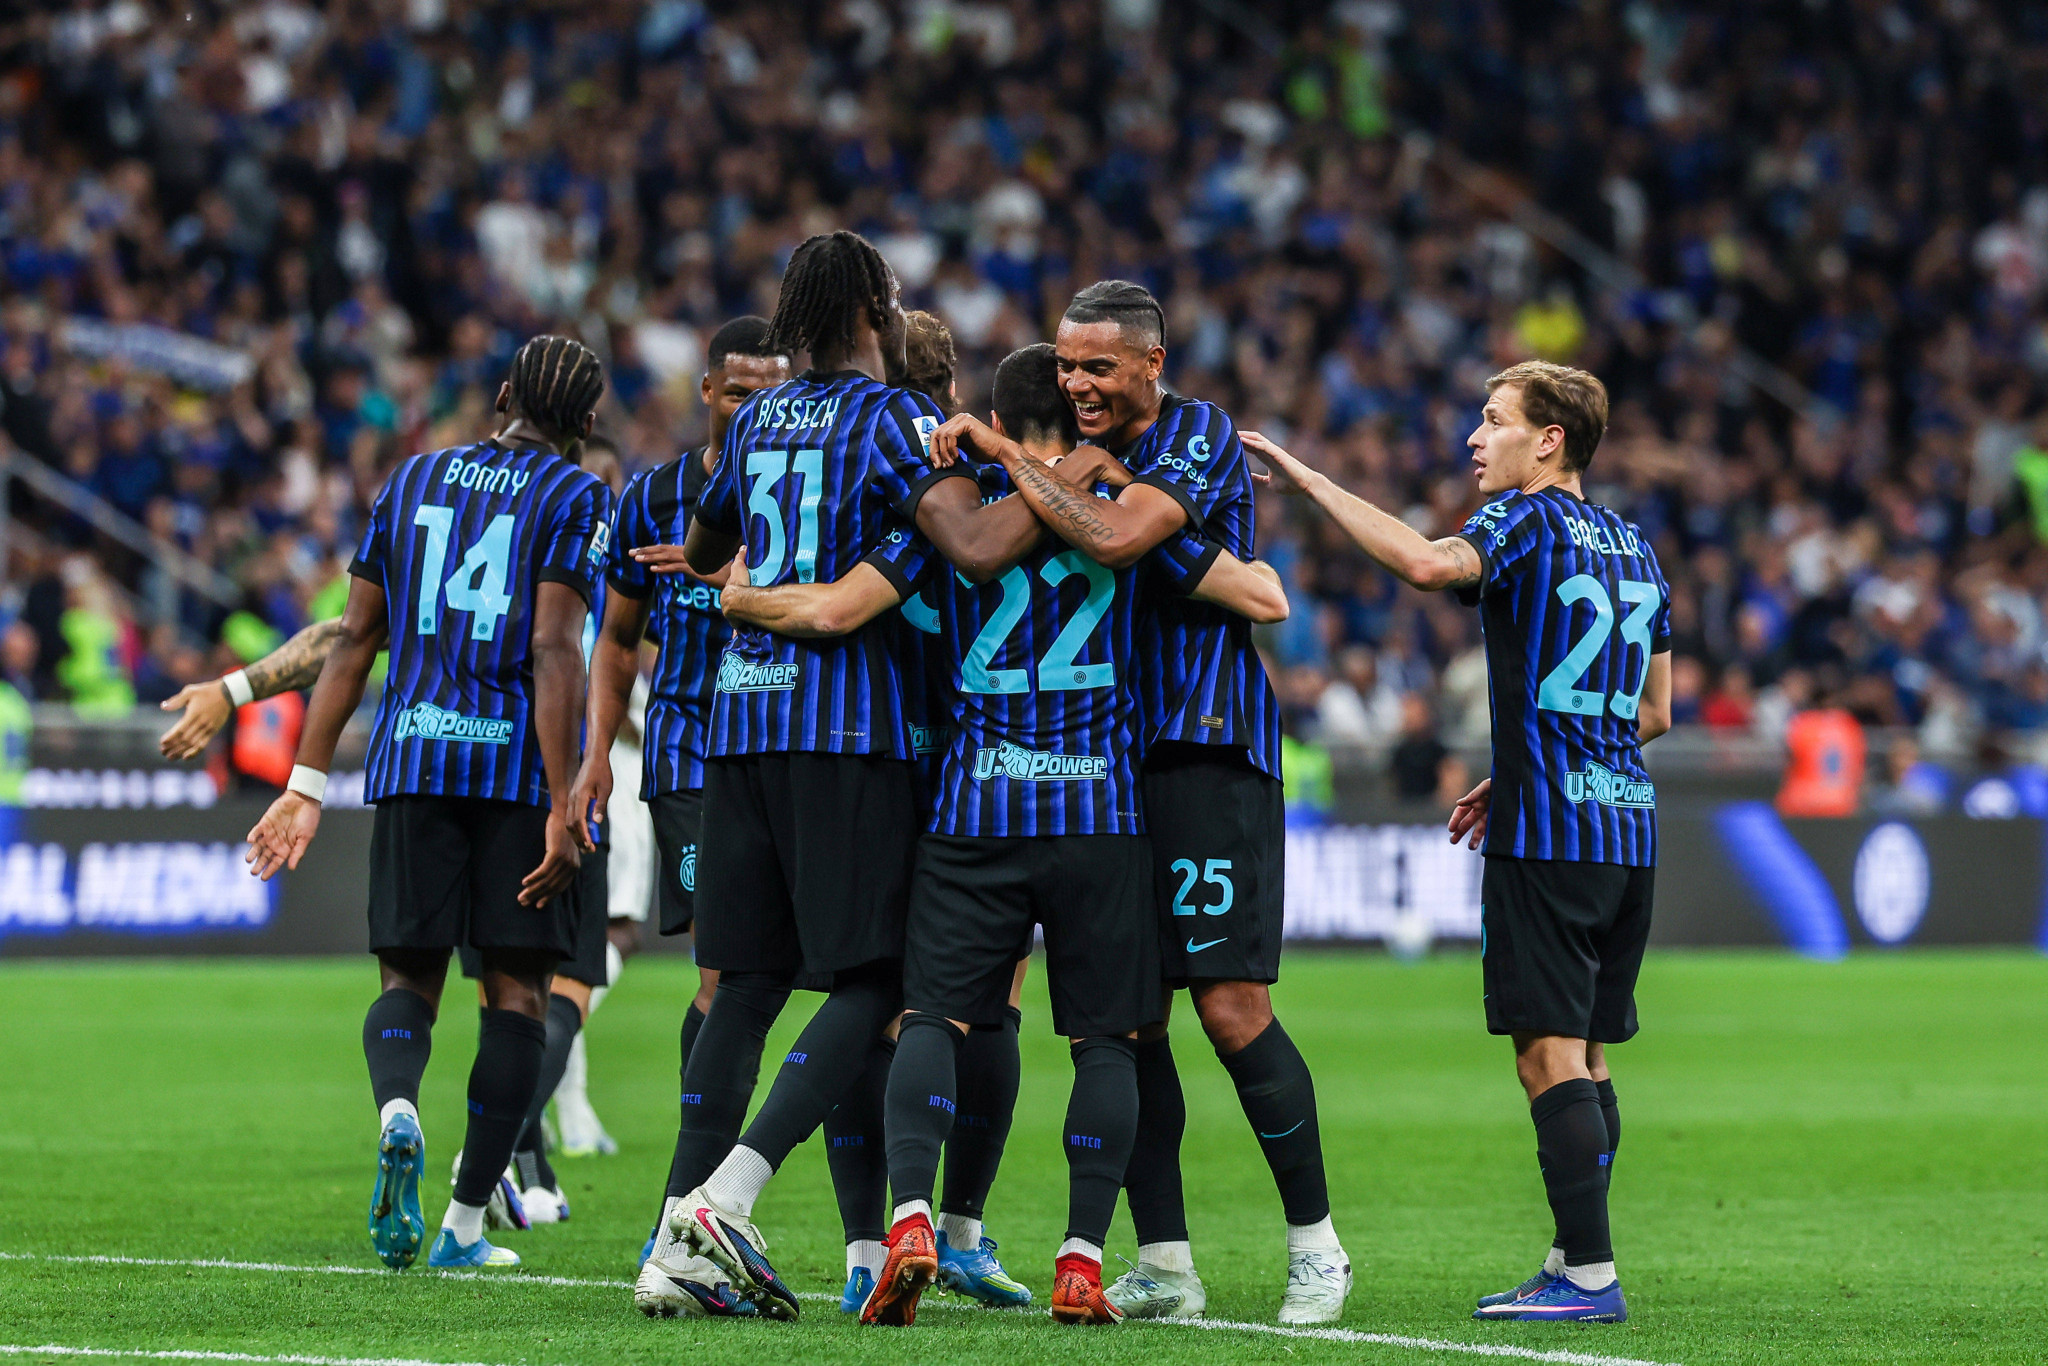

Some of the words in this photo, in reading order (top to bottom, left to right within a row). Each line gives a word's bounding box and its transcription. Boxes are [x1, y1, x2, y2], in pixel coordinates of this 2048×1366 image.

[754, 397, 840, 430] BISSECK
[442, 457, 530, 497] BONNY
[1157, 452, 1208, 490] Gate.io
[745, 449, 824, 588] 31
[1562, 515, 1645, 558] BAELLA
[413, 503, 516, 642] 14
[955, 550, 1117, 694] 22
[1537, 574, 1661, 720] 23
[1170, 858, 1234, 916] 25
[382, 1028, 412, 1041] INTER
[929, 1094, 957, 1115] INTER
[1071, 1134, 1102, 1150] INTER
